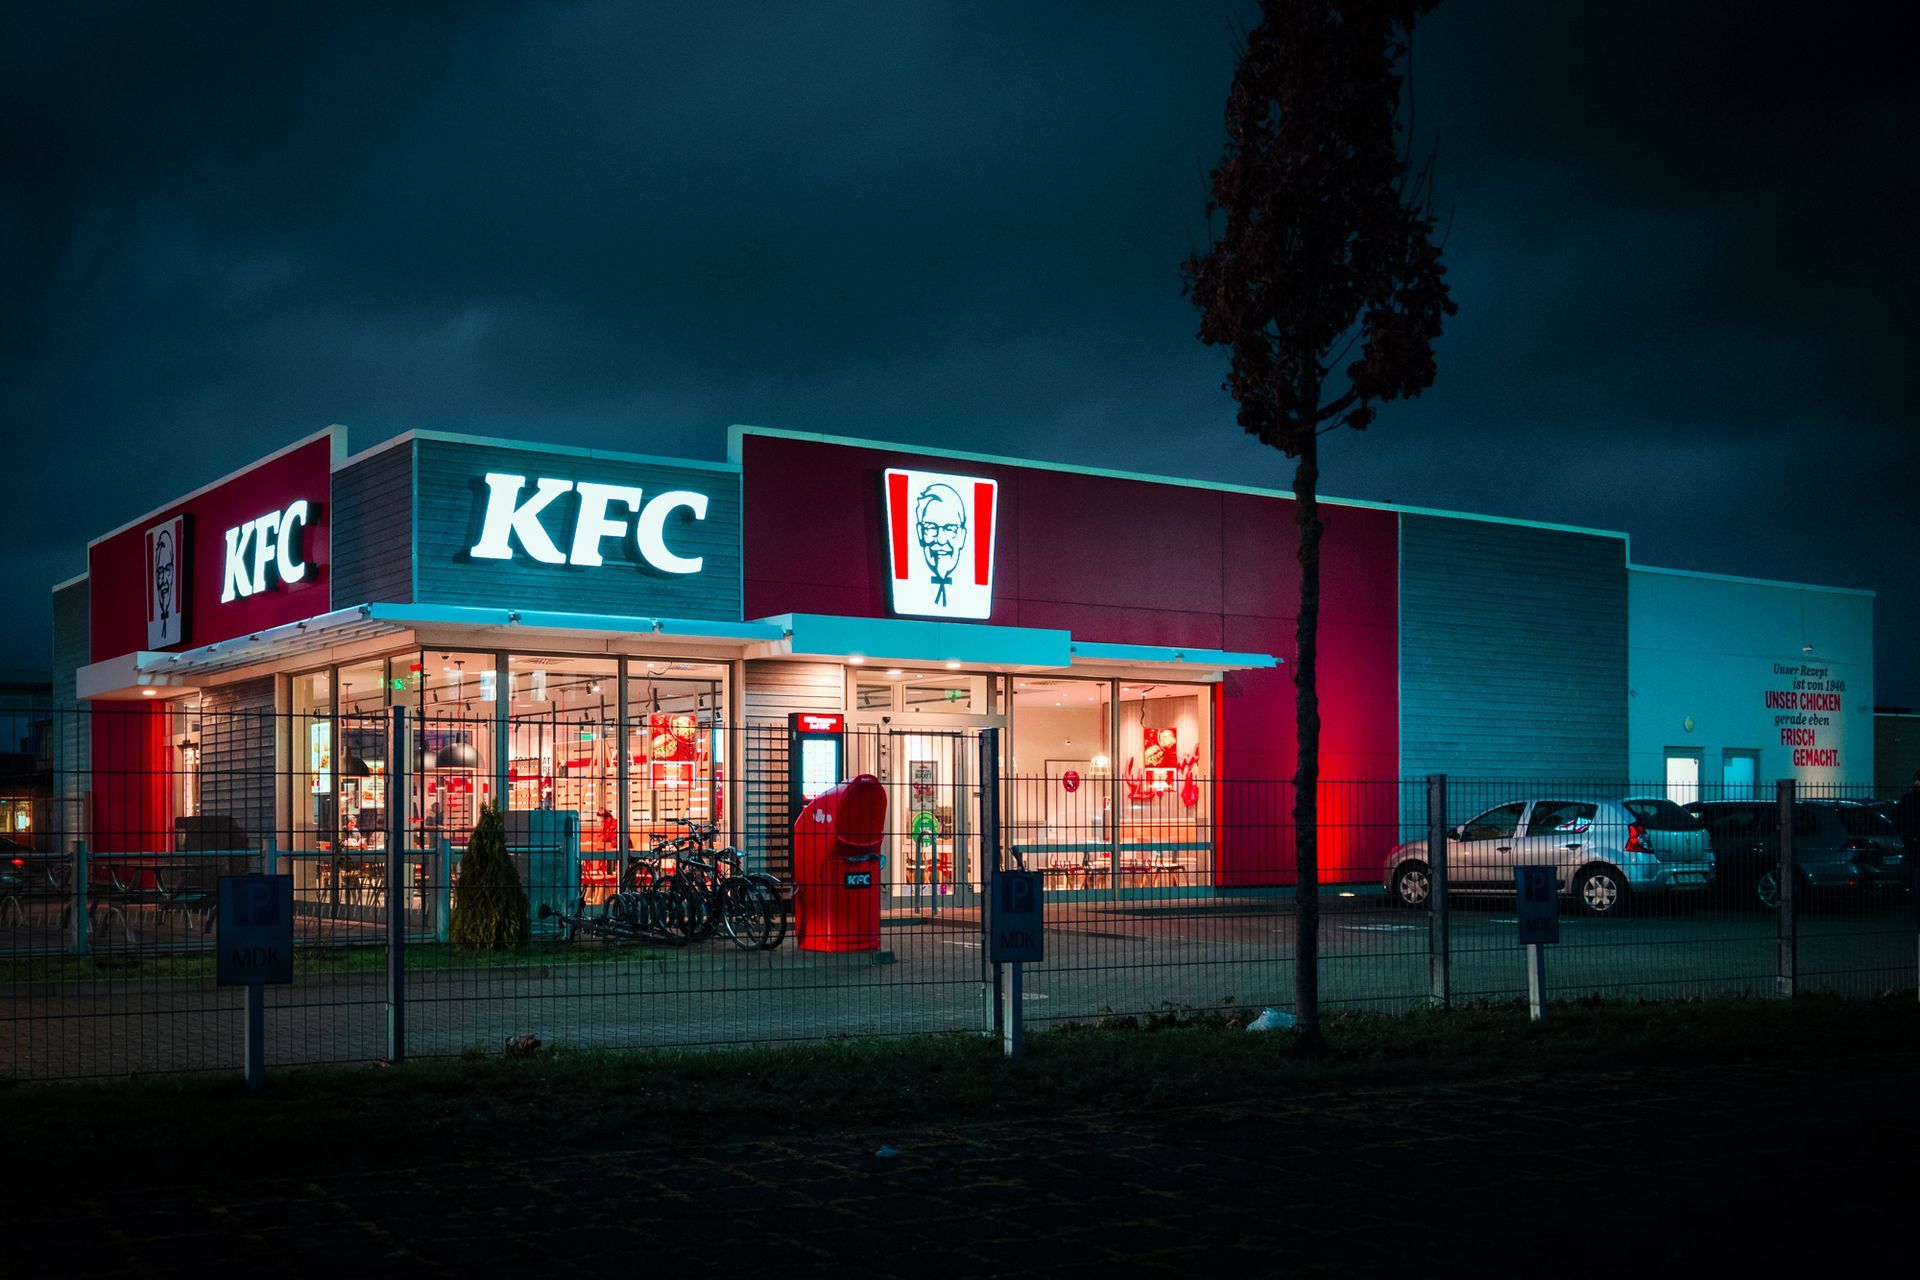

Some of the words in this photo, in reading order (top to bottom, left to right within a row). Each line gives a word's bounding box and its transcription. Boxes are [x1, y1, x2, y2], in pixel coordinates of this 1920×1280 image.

[470, 472, 709, 574] KFC
[221, 500, 308, 604] KFC
[1773, 663, 1799, 675] Unser
[1800, 665, 1828, 679] Rezept
[1793, 677, 1805, 690] ist
[1807, 681, 1823, 690] von
[1826, 680, 1847, 692] 1940.
[1765, 690, 1797, 709] UNSER
[1800, 692, 1840, 711] CHICKEN
[1774, 713, 1806, 726] gerade
[1808, 714, 1829, 726] eben
[1781, 728, 1815, 746] FRISCH
[1793, 749, 1840, 766] GEMACHT.
[847, 874, 870, 885] KFC
[247, 881, 273, 923] P
[1012, 879, 1029, 911] P
[1001, 931, 1035, 949] MDK
[232, 947, 281, 968] MDK
